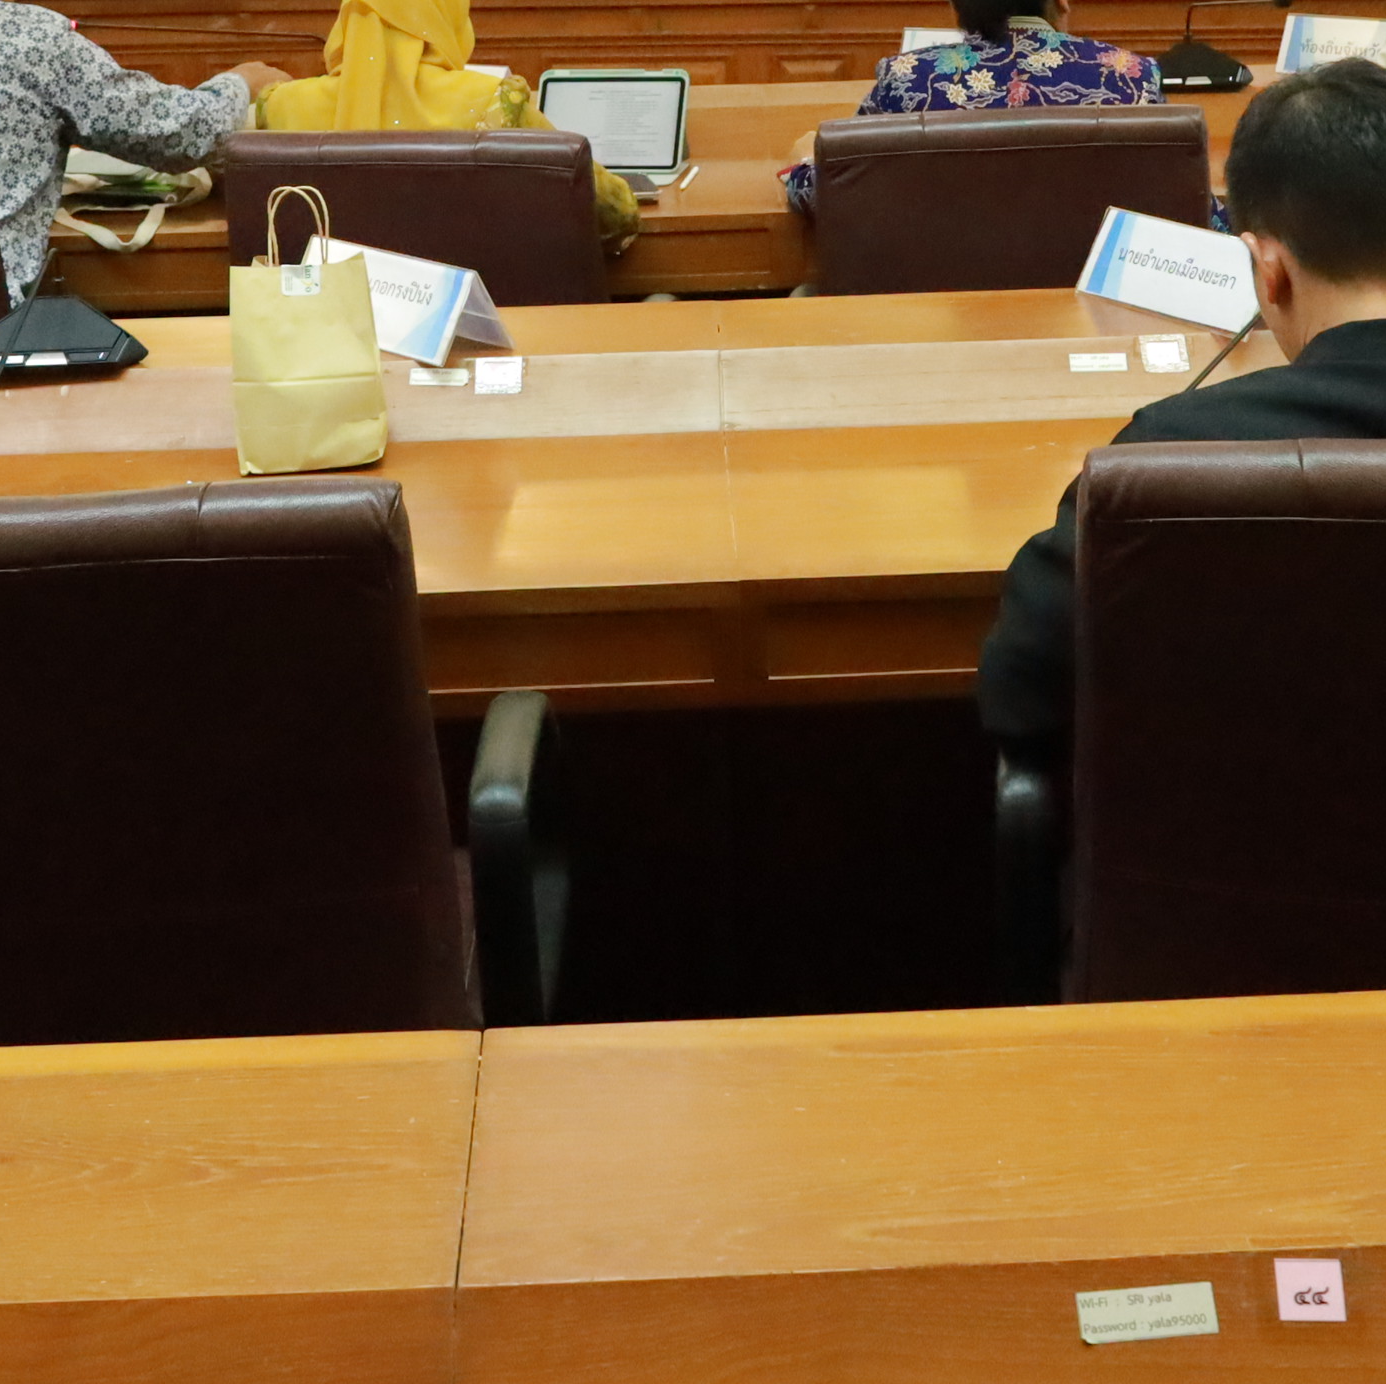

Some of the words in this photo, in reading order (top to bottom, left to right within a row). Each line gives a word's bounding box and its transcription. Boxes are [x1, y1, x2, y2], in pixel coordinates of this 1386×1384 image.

[1117, 246, 1237, 290] นายอำเภอเมืองยะลา
[369, 277, 433, 306] ภอกรงปินัง
[1079, 1297, 1108, 1310] Wi-Fi
[1127, 1294, 1144, 1306] SRI
[1148, 1292, 1172, 1307] yala
[1083, 1319, 1136, 1335] Password
[1148, 1314, 1207, 1332] yala95000
